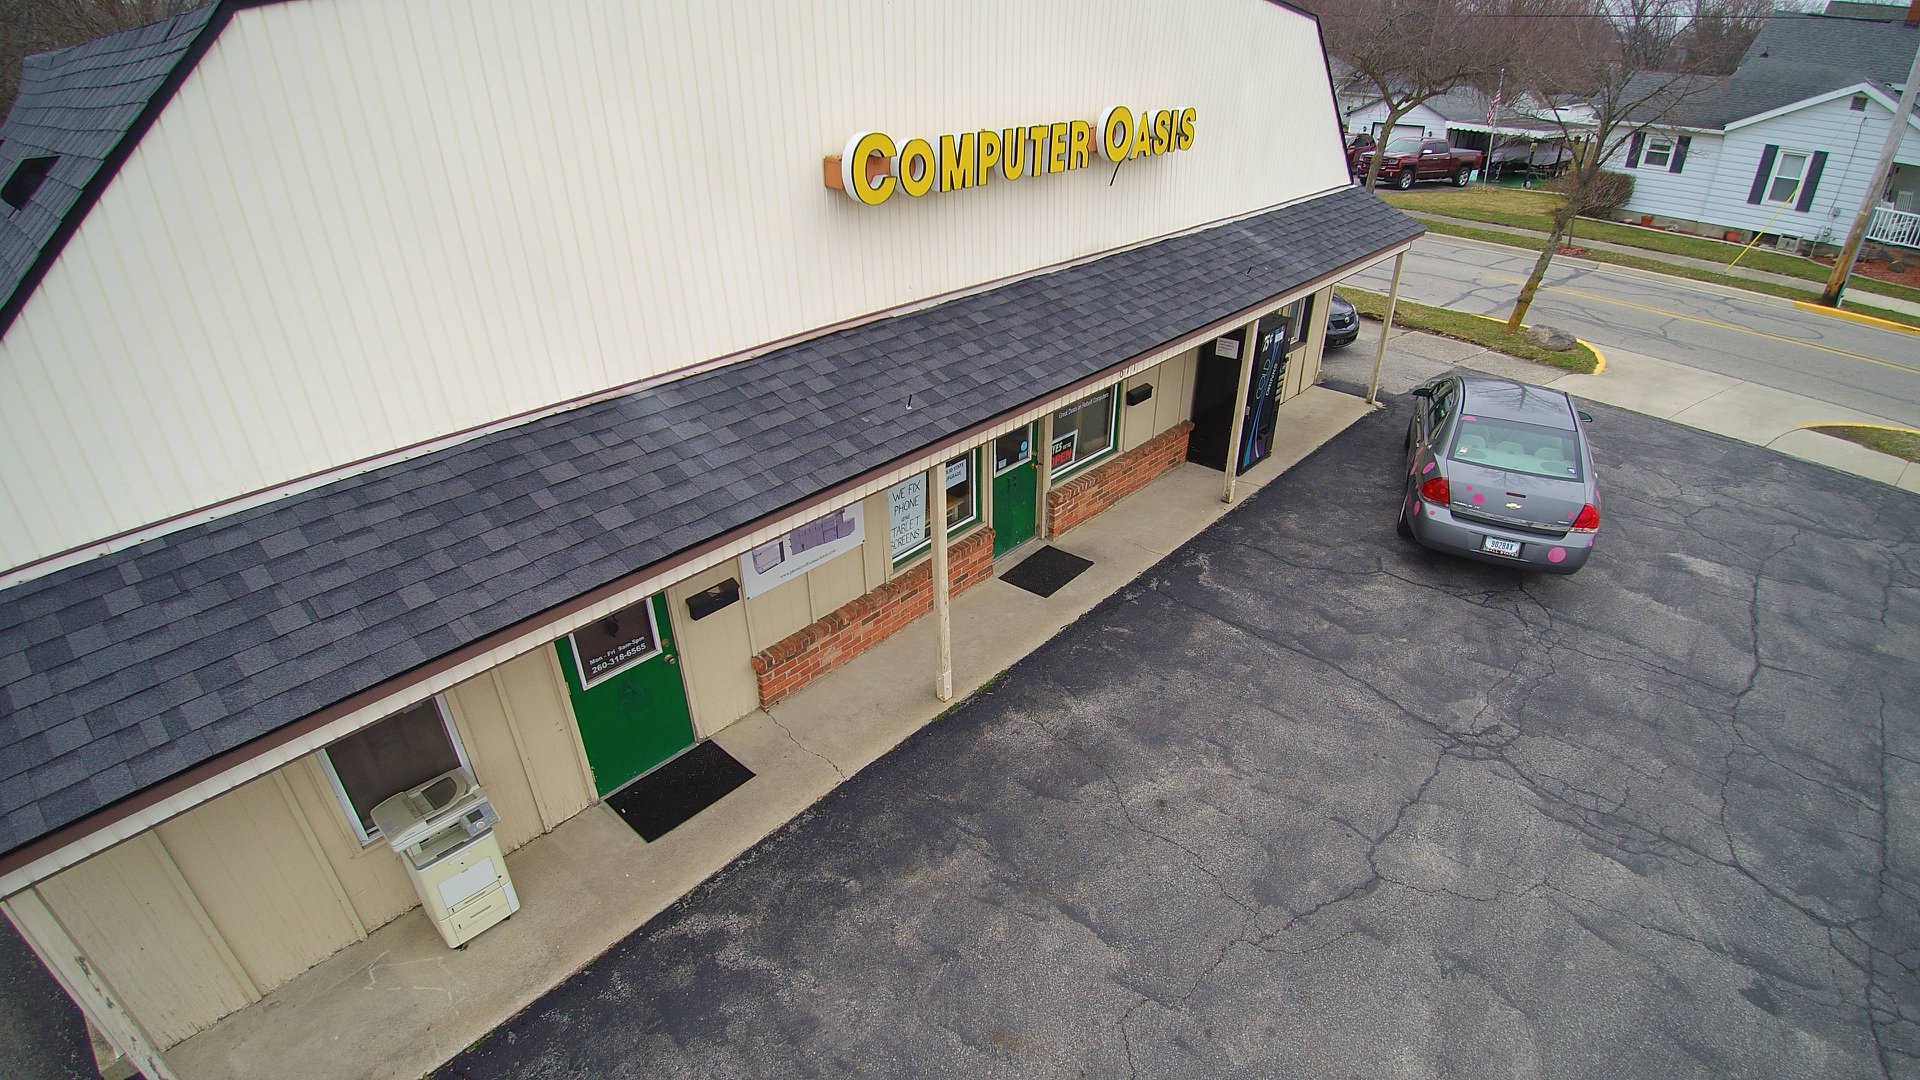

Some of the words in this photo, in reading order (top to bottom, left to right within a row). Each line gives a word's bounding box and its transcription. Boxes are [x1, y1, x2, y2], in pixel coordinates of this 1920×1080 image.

[846, 120, 1090, 206] COMPUTER
[1101, 104, 1197, 165] OASIS
[1256, 359, 1271, 400] COLD
[1265, 363, 1279, 396] DRINKS
[892, 486, 906, 502] WE
[908, 479, 921, 496] FIX
[894, 495, 920, 516] PHONE
[901, 513, 911, 522] and
[890, 528, 920, 552] SCREENS
[589, 656, 603, 665] Mon
[606, 649, 616, 657] Fri
[617, 636, 645, 651] 9am-5pm
[591, 643, 646, 674] 260-318-6565
